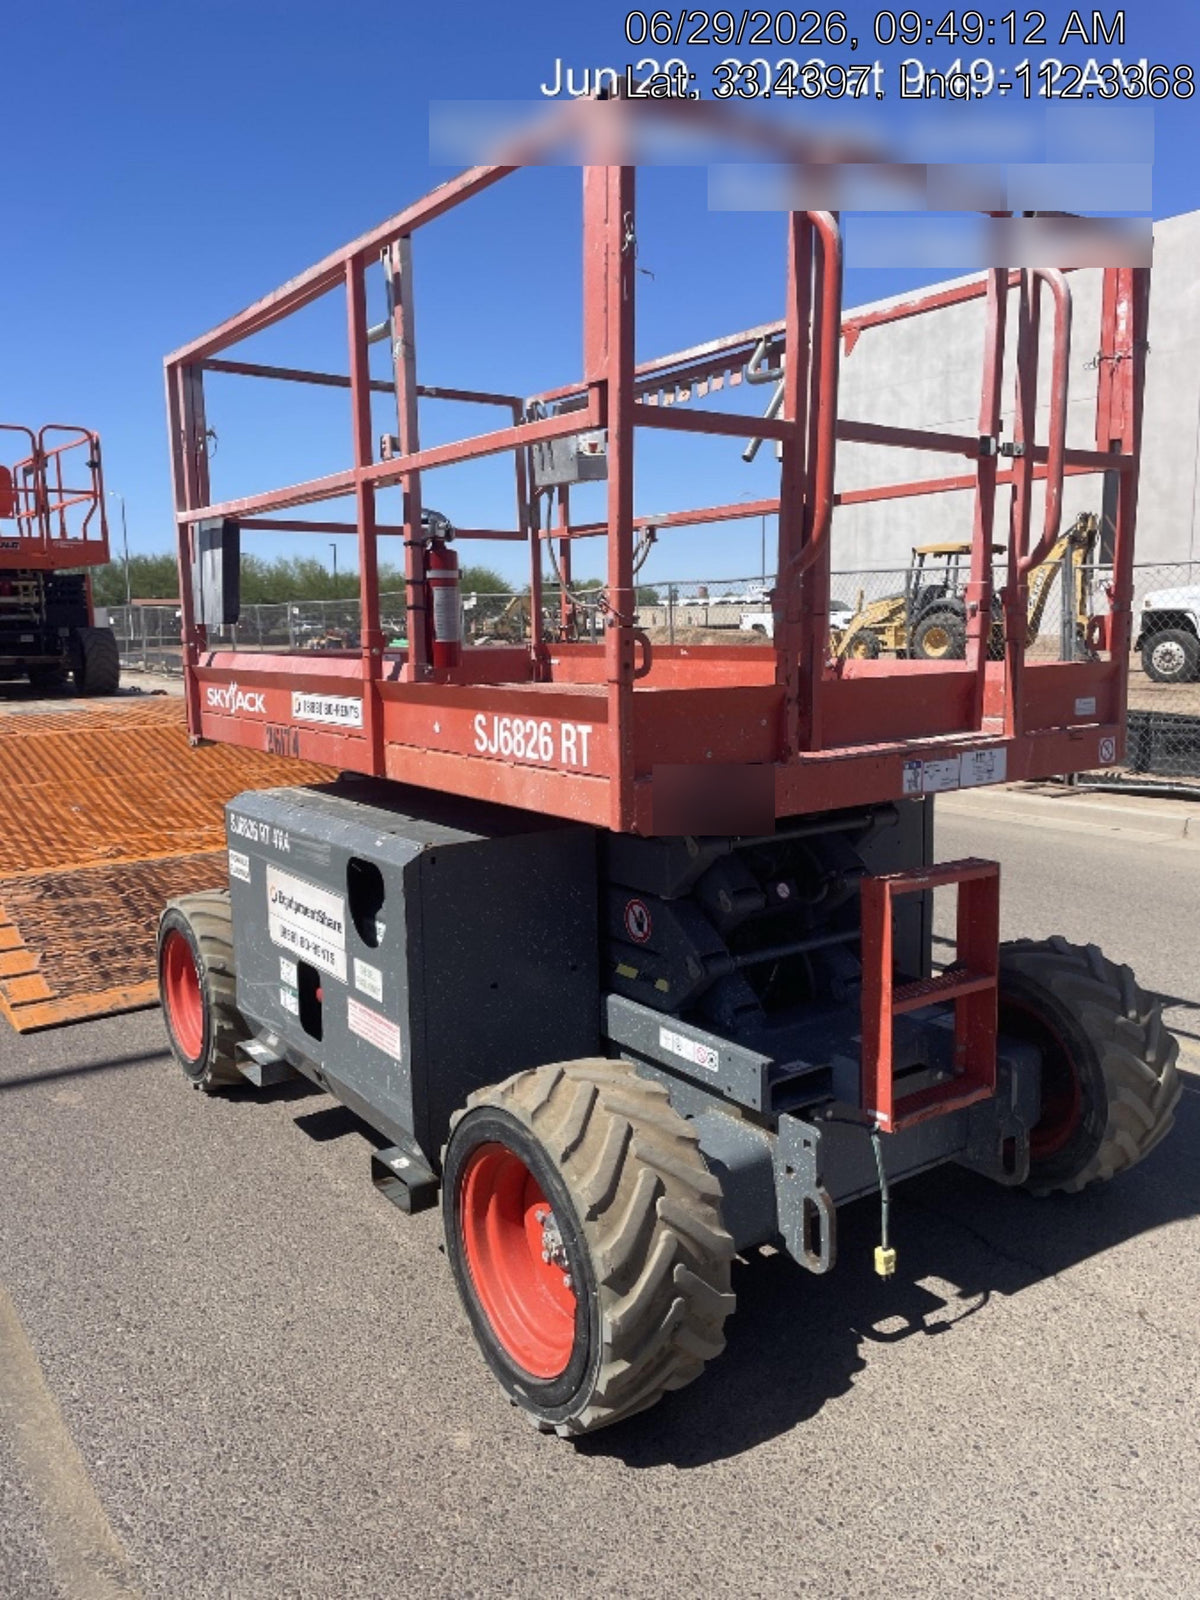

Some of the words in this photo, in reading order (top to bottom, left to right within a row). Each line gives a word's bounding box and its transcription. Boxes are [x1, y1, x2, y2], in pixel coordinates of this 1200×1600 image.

[207, 681, 267, 714] SKYJACK
[474, 713, 554, 762] SJ6826
[561, 722, 593, 767] RT
